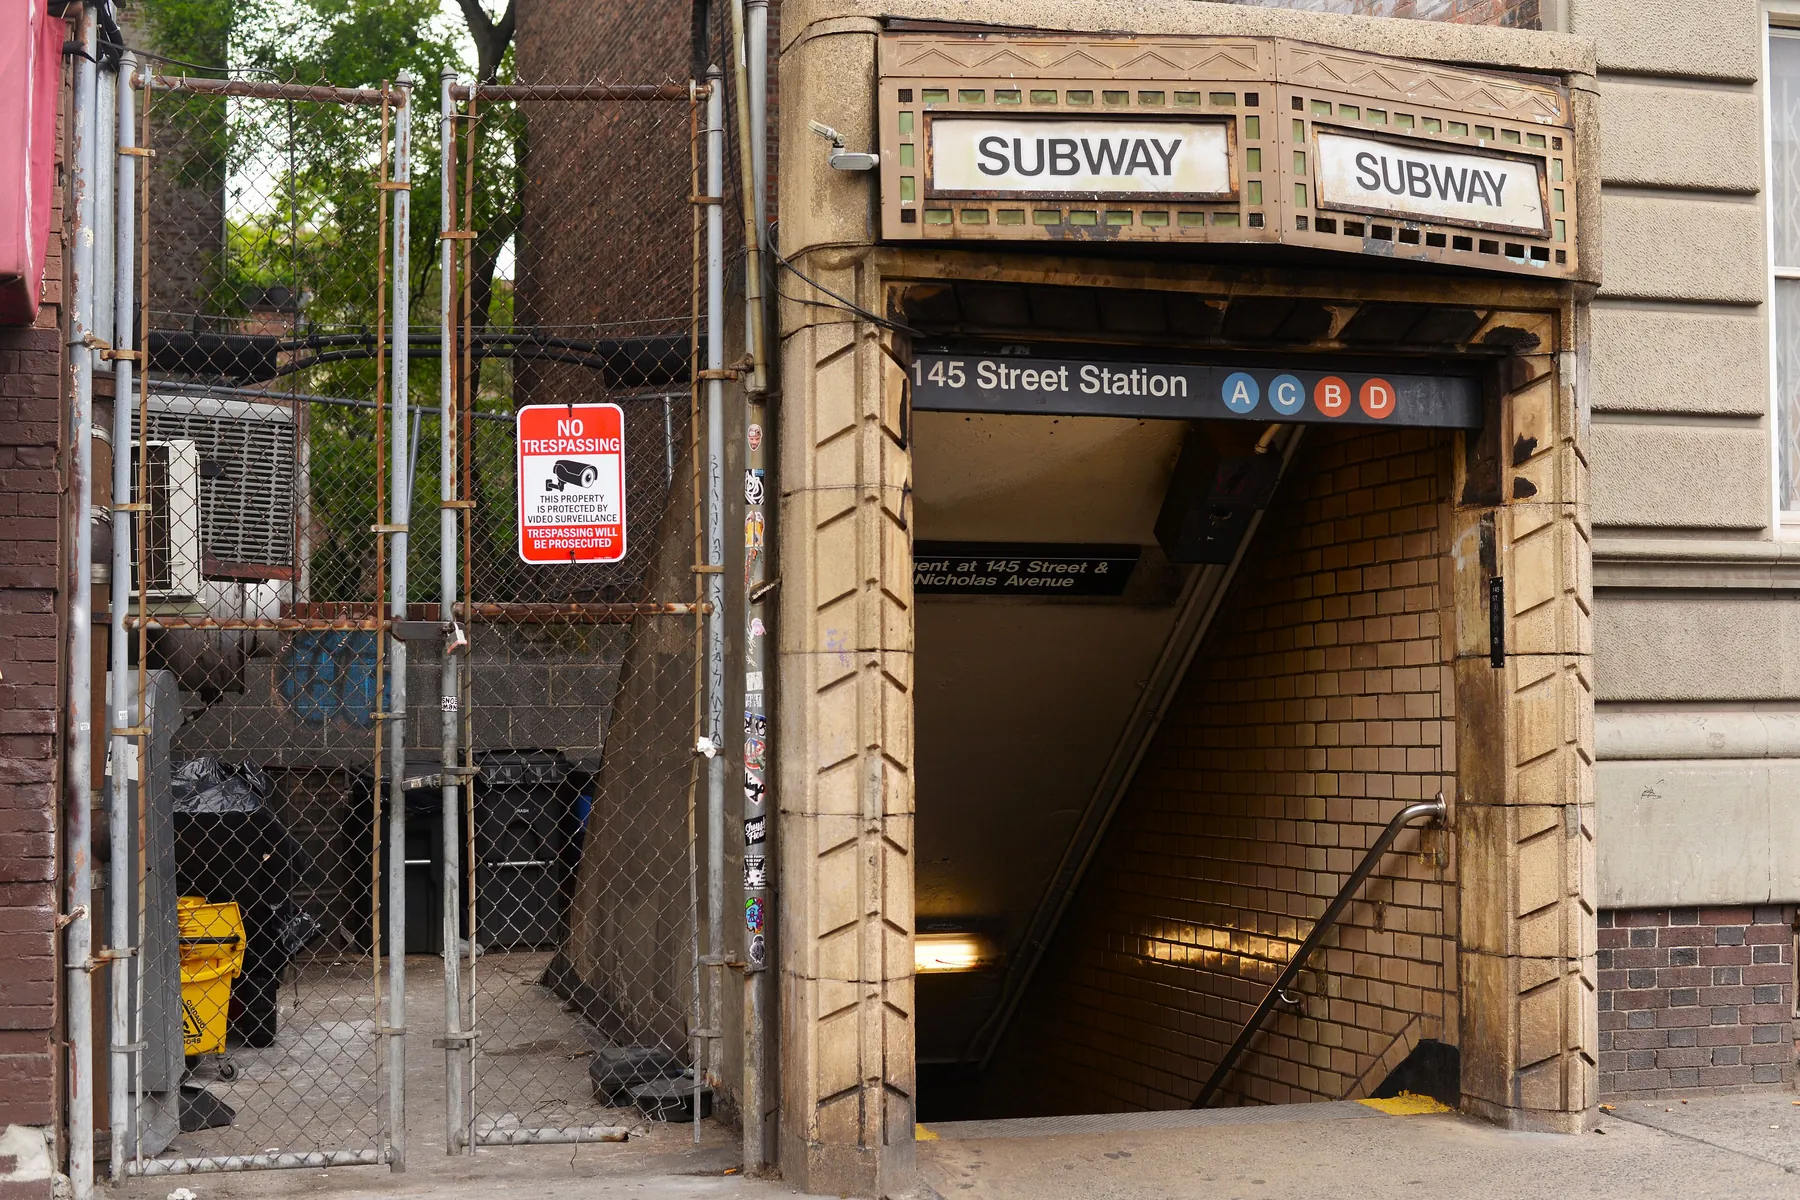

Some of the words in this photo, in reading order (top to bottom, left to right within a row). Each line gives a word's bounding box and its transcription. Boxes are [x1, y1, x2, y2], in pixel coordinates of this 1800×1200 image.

[977, 136, 1182, 177] SUBWAY
[1355, 151, 1507, 207] SUBWAY
[911, 360, 966, 388] 145
[976, 360, 1069, 391] Street
[1079, 364, 1187, 398] Station
[1231, 380, 1250, 404] A
[1277, 382, 1296, 406] C
[1325, 384, 1342, 408] B
[1370, 386, 1388, 409] D
[557, 419, 584, 437] NO
[522, 438, 620, 453] TRESPASSING
[540, 495, 559, 503] THIS
[561, 494, 605, 503] PROPERTY
[537, 505, 546, 514] IS
[547, 504, 595, 513] PROTECTED
[597, 504, 608, 513] BY
[527, 515, 553, 524] VIDEO
[555, 513, 617, 523] SURVEILLANCE
[527, 528, 593, 538] TRESPASSING
[594, 527, 618, 537] WILL
[534, 539, 547, 549] BE
[548, 538, 612, 549] PROSECUTED
[956, 561, 977, 572] at
[986, 560, 1020, 572] 145
[1026, 561, 1088, 573] Street
[1094, 561, 1109, 574] &
[914, 574, 997, 586] Nicholas
[1004, 574, 1074, 587] Avenue
